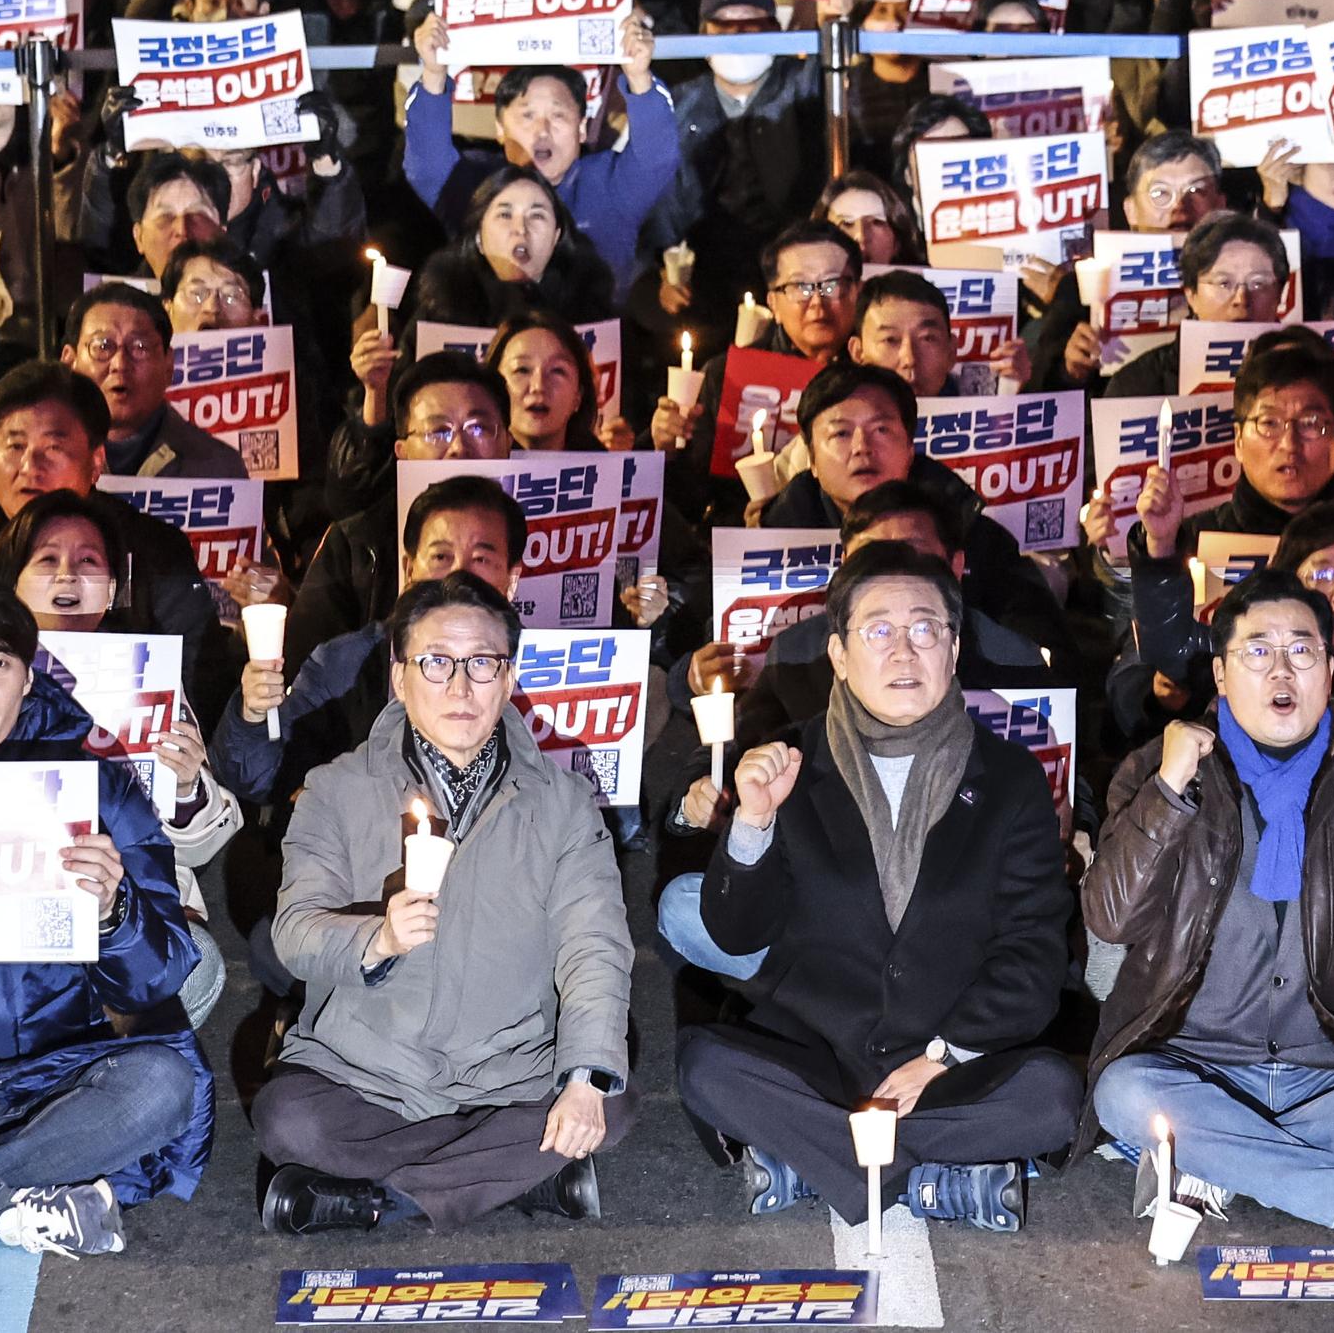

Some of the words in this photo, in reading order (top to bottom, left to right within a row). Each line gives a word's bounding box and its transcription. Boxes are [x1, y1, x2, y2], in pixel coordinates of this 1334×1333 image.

[138, 22, 277, 68] 국정농단
[516, 38, 552, 53] 민주당
[133, 78, 214, 110] 윤석열
[215, 60, 298, 104] OUT!
[1200, 84, 1286, 127] 윤석열
[203, 124, 238, 138] 민주당
[933, 201, 1018, 237] 윤석열
[194, 383, 284, 429] OUT!
[979, 436, 1077, 494] OUT!
[521, 521, 608, 568] OUT!
[530, 699, 630, 745] OUT!
